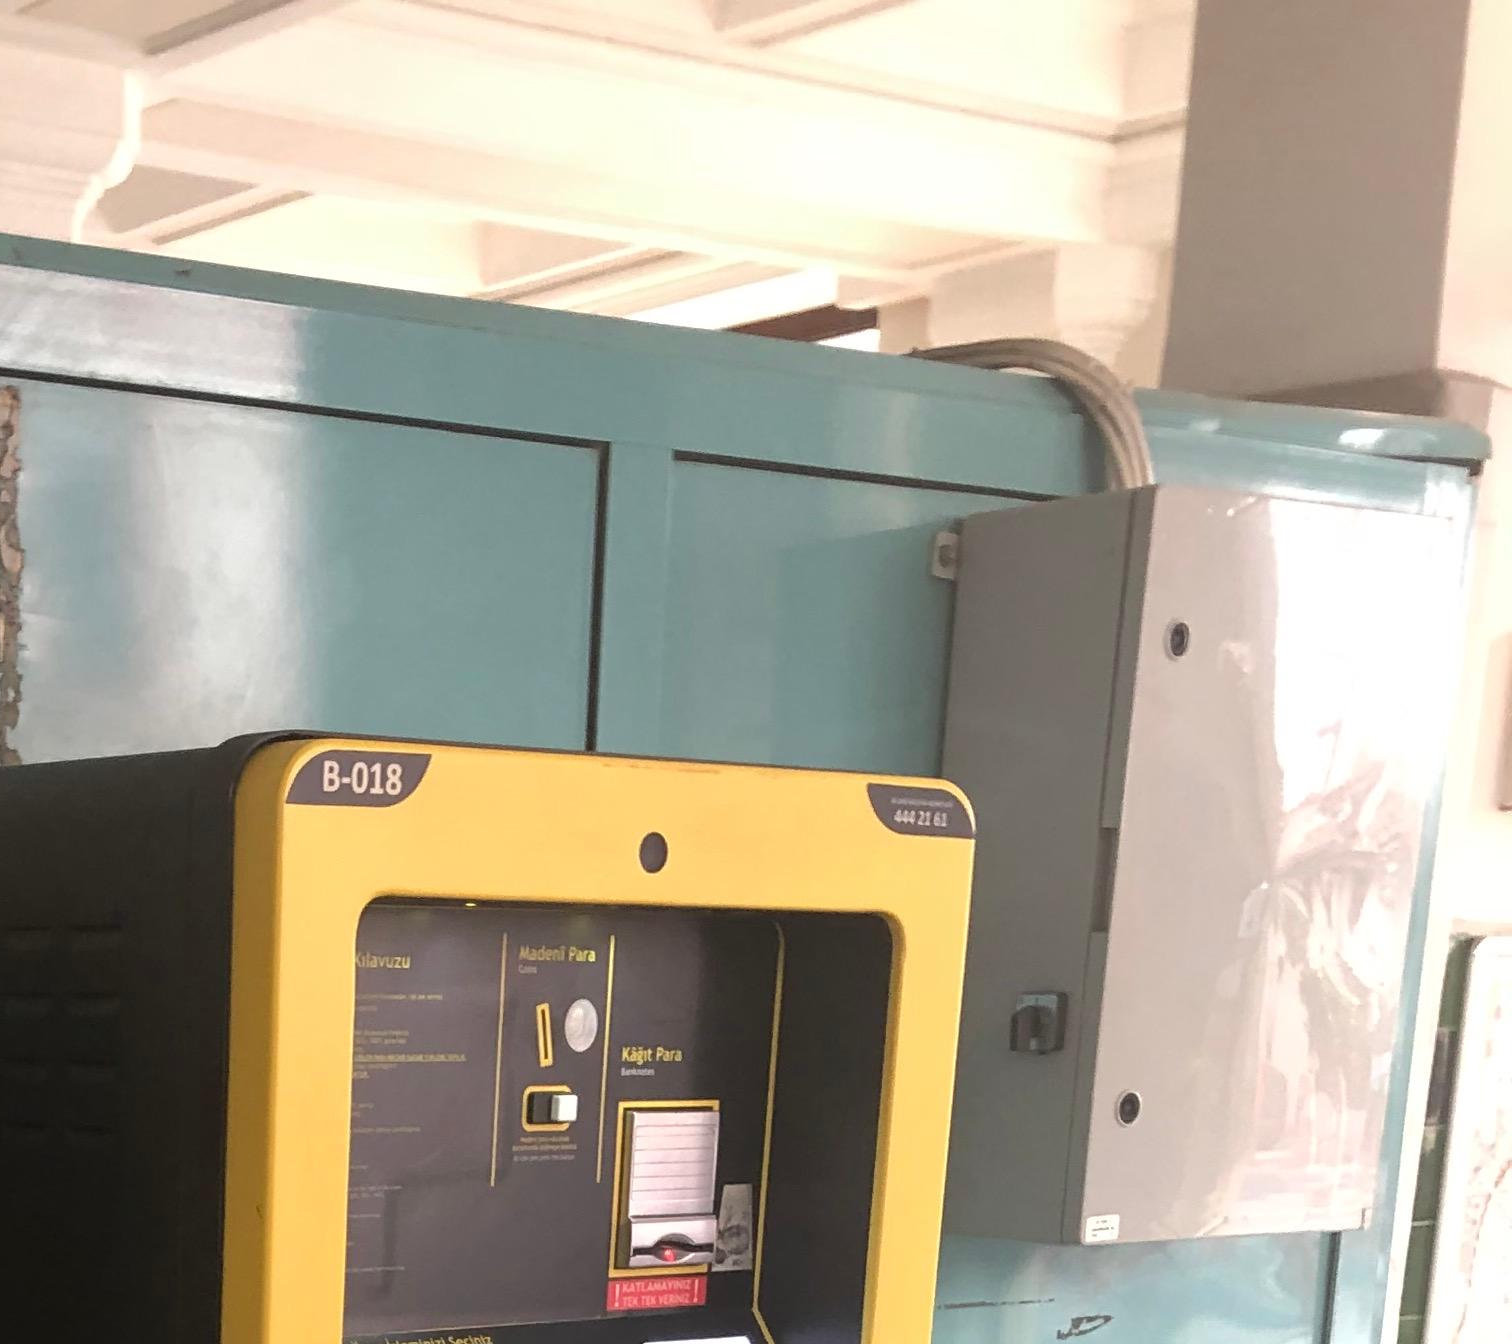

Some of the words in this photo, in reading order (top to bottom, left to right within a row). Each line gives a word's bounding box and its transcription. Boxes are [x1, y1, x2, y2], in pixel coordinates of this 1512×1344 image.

[322, 760, 403, 796] B-018
[569, 946, 596, 962] Para
[656, 1046, 683, 1062] Para
